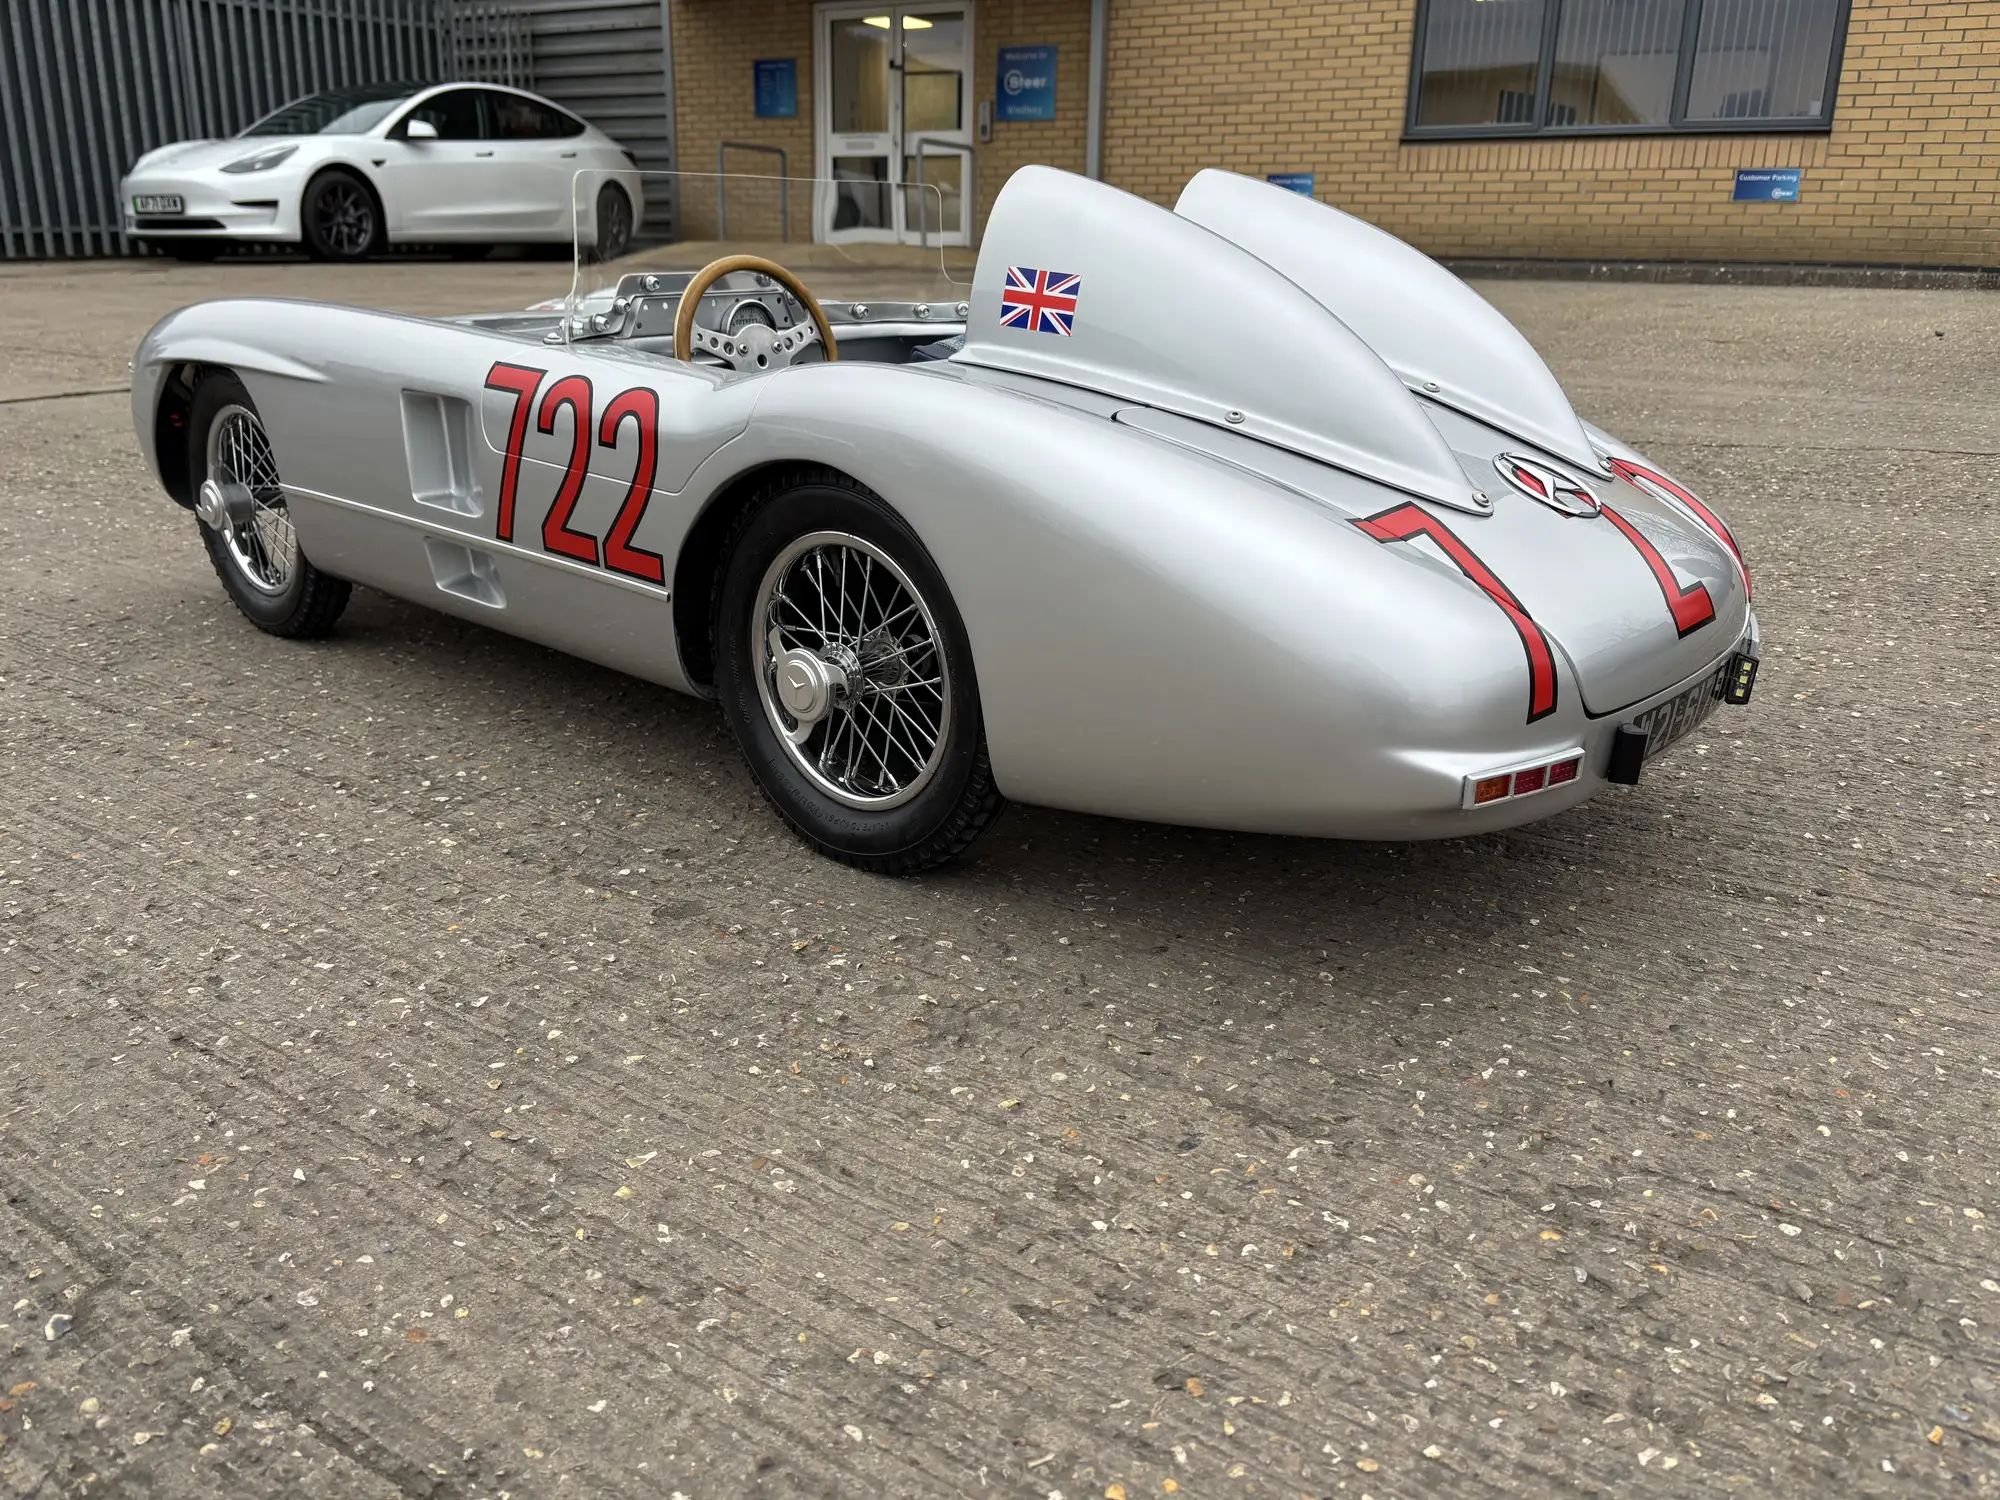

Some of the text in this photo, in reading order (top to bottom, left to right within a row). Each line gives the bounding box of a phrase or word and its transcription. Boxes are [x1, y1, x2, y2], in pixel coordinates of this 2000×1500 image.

[1739, 173, 1797, 183] Customer Parking
[484, 361, 666, 587] 722
